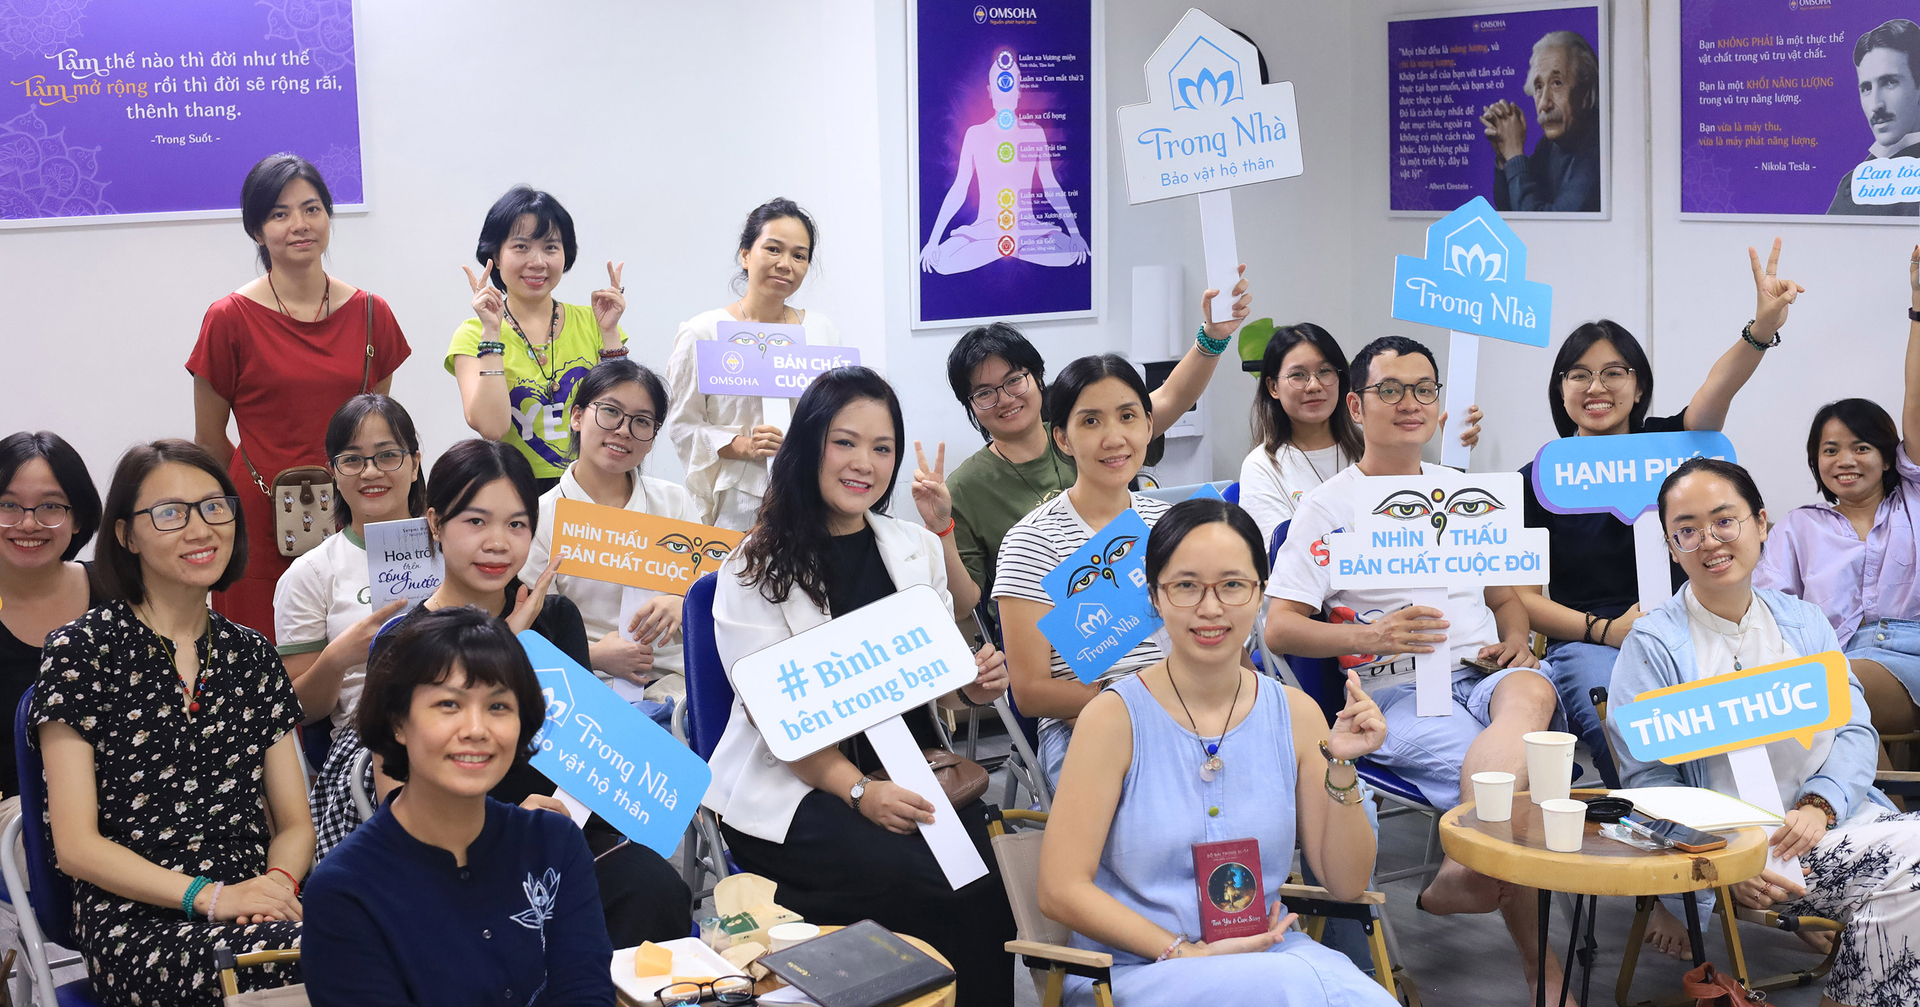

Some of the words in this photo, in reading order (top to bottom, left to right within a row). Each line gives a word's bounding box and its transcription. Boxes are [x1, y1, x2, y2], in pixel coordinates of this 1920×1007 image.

[989, 7, 1037, 19] OMSOHA
[1480, 20, 1506, 28] OMSOHA
[1699, 40, 1715, 51] Bạn
[1717, 36, 1749, 48] KHÔNG
[1751, 34, 1773, 46] PHẢI
[1776, 36, 1784, 45] là
[1786, 35, 1804, 47] một
[1806, 34, 1827, 45] thực
[1829, 31, 1845, 43] thể
[45, 48, 110, 78] Tâm
[105, 51, 135, 69] thế
[142, 54, 174, 68] nào
[181, 51, 204, 67] thì
[210, 51, 236, 67] đời
[243, 49, 275, 66] như
[281, 48, 310, 66] thế
[1698, 53, 1712, 65] vật
[1713, 51, 1732, 62] chất
[1735, 53, 1758, 63] trong
[1760, 51, 1770, 60] vũ
[1772, 52, 1785, 62] trụ
[1787, 49, 1801, 61] vật
[1804, 47, 1826, 58] chất.
[10, 75, 77, 106] Tâm
[74, 79, 101, 96] mở
[107, 79, 148, 97] rộng
[154, 78, 177, 94] rồi
[183, 76, 208, 92] thì
[213, 76, 240, 93] đời
[246, 75, 265, 91] sẽ
[271, 77, 310, 95] rộng
[315, 76, 342, 91] rãi,
[1699, 81, 1715, 93] Bạn
[1717, 80, 1725, 90] là
[1727, 80, 1744, 92] một
[1746, 75, 1769, 89] KHỐI
[1772, 76, 1798, 88] NĂNG
[1801, 76, 1834, 89] LƯỢNG
[1699, 96, 1722, 106] trong
[1723, 94, 1733, 104] vũ
[1735, 95, 1749, 105] trụ
[1751, 93, 1773, 105] năng
[1774, 92, 1801, 105] lượng.
[126, 102, 178, 119] thênh
[184, 101, 241, 120] thang.
[1137, 128, 1227, 160] Trong
[1231, 112, 1287, 147] Nhà
[1699, 122, 1716, 134] Bạn
[1717, 122, 1732, 132] vừa
[1734, 122, 1742, 131] là
[1744, 121, 1762, 133] máy
[189, 133, 211, 145] Suốt
[1698, 136, 1713, 146] vừa
[1715, 136, 1723, 145] là
[1725, 136, 1742, 148] máy
[1745, 135, 1764, 147] phát
[1767, 135, 1789, 147] năng
[1791, 135, 1818, 147] lượng.
[1161, 171, 1189, 187] Bảo
[1194, 166, 1215, 183] vật
[1220, 162, 1238, 178] hộ
[1242, 157, 1275, 173] thân
[1761, 161, 1786, 170] Nikola
[1788, 161, 1810, 170] Tesla
[1856, 165, 1893, 180] Lan
[1429, 182, 1445, 190] Albert
[1446, 182, 1469, 190] Einstein
[1857, 183, 1896, 197] bình
[1405, 277, 1483, 326] Trong
[1490, 291, 1537, 329] Nhà
[773, 353, 807, 370] BẢN
[709, 375, 760, 387] OMSOHA
[511, 402, 572, 440] YE
[1554, 459, 1637, 491] HẠNH
[1645, 451, 1724, 481] PH
[562, 522, 602, 542] NHÌN
[605, 529, 648, 550] THẤU
[1372, 526, 1424, 548] NHÌN
[1449, 522, 1508, 545] THẤU
[384, 550, 411, 562] Hoa
[403, 562, 421, 570] trên
[559, 543, 596, 564] BẢN
[599, 552, 642, 572] CHẤT
[645, 561, 689, 581] CUỘC
[1339, 554, 1382, 575] BẢN
[1387, 550, 1440, 574] CHẤT
[1444, 551, 1500, 576] CUỘC
[1504, 553, 1541, 572] ĐỜI
[378, 568, 412, 595] sóng
[408, 574, 442, 589] nước
[1076, 633, 1119, 662] Trong
[1111, 614, 1140, 638] Nhà
[777, 659, 809, 702] #
[813, 639, 891, 689] Bình
[891, 626, 933, 656] an
[780, 710, 833, 742] bên
[832, 678, 905, 720] trong
[898, 657, 951, 690] bạn
[1630, 704, 1716, 746] TỈNH
[1718, 681, 1818, 726] THỨC
[575, 713, 635, 783] Trong
[637, 761, 678, 811] Nhà
[530, 727, 553, 752] ảo
[558, 749, 585, 775] vật
[587, 767, 609, 796] hộ
[613, 787, 650, 825] thân
